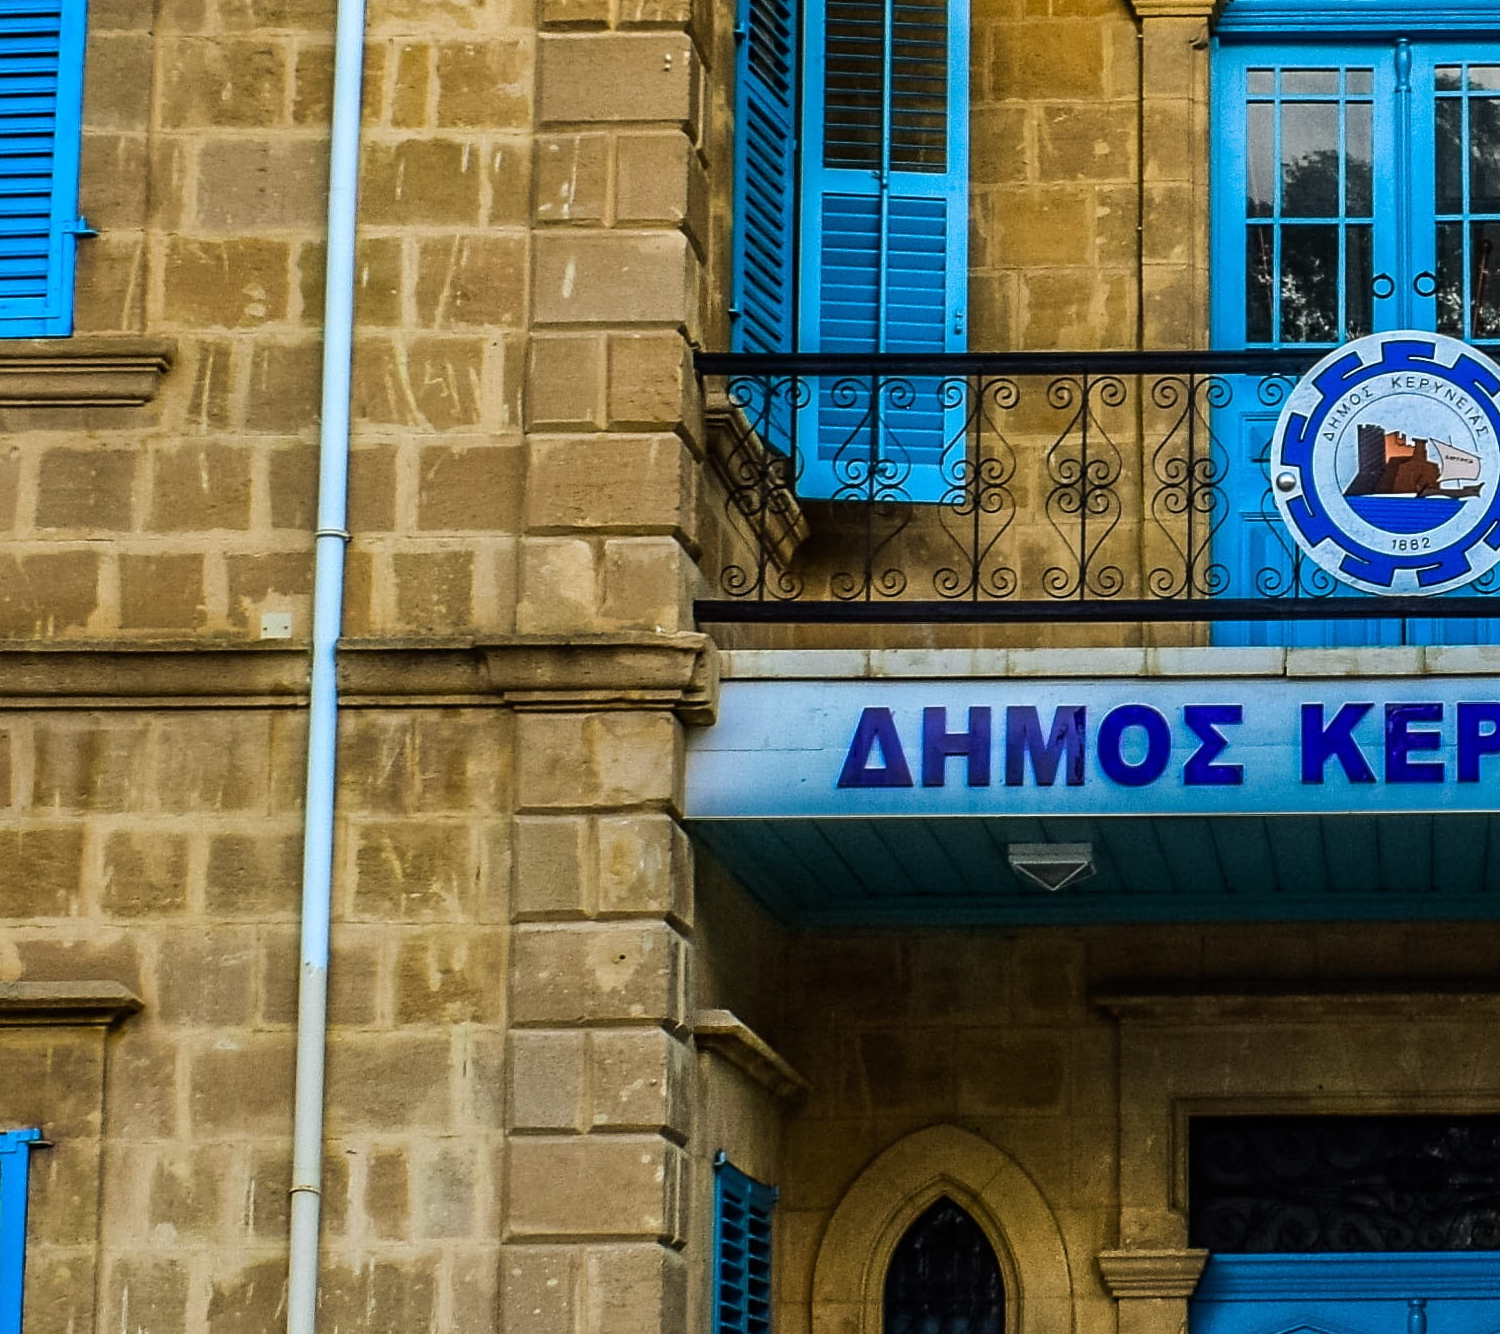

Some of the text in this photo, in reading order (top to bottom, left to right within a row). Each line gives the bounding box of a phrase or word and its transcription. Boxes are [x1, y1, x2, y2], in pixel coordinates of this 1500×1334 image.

[1323, 376, 1489, 442] ΔΗΜΟΣ ΚΕΡΥΝΕΙΑΣ
[1392, 537, 1431, 551] 1882
[837, 703, 1244, 788] ΔΗΜΟΣ
